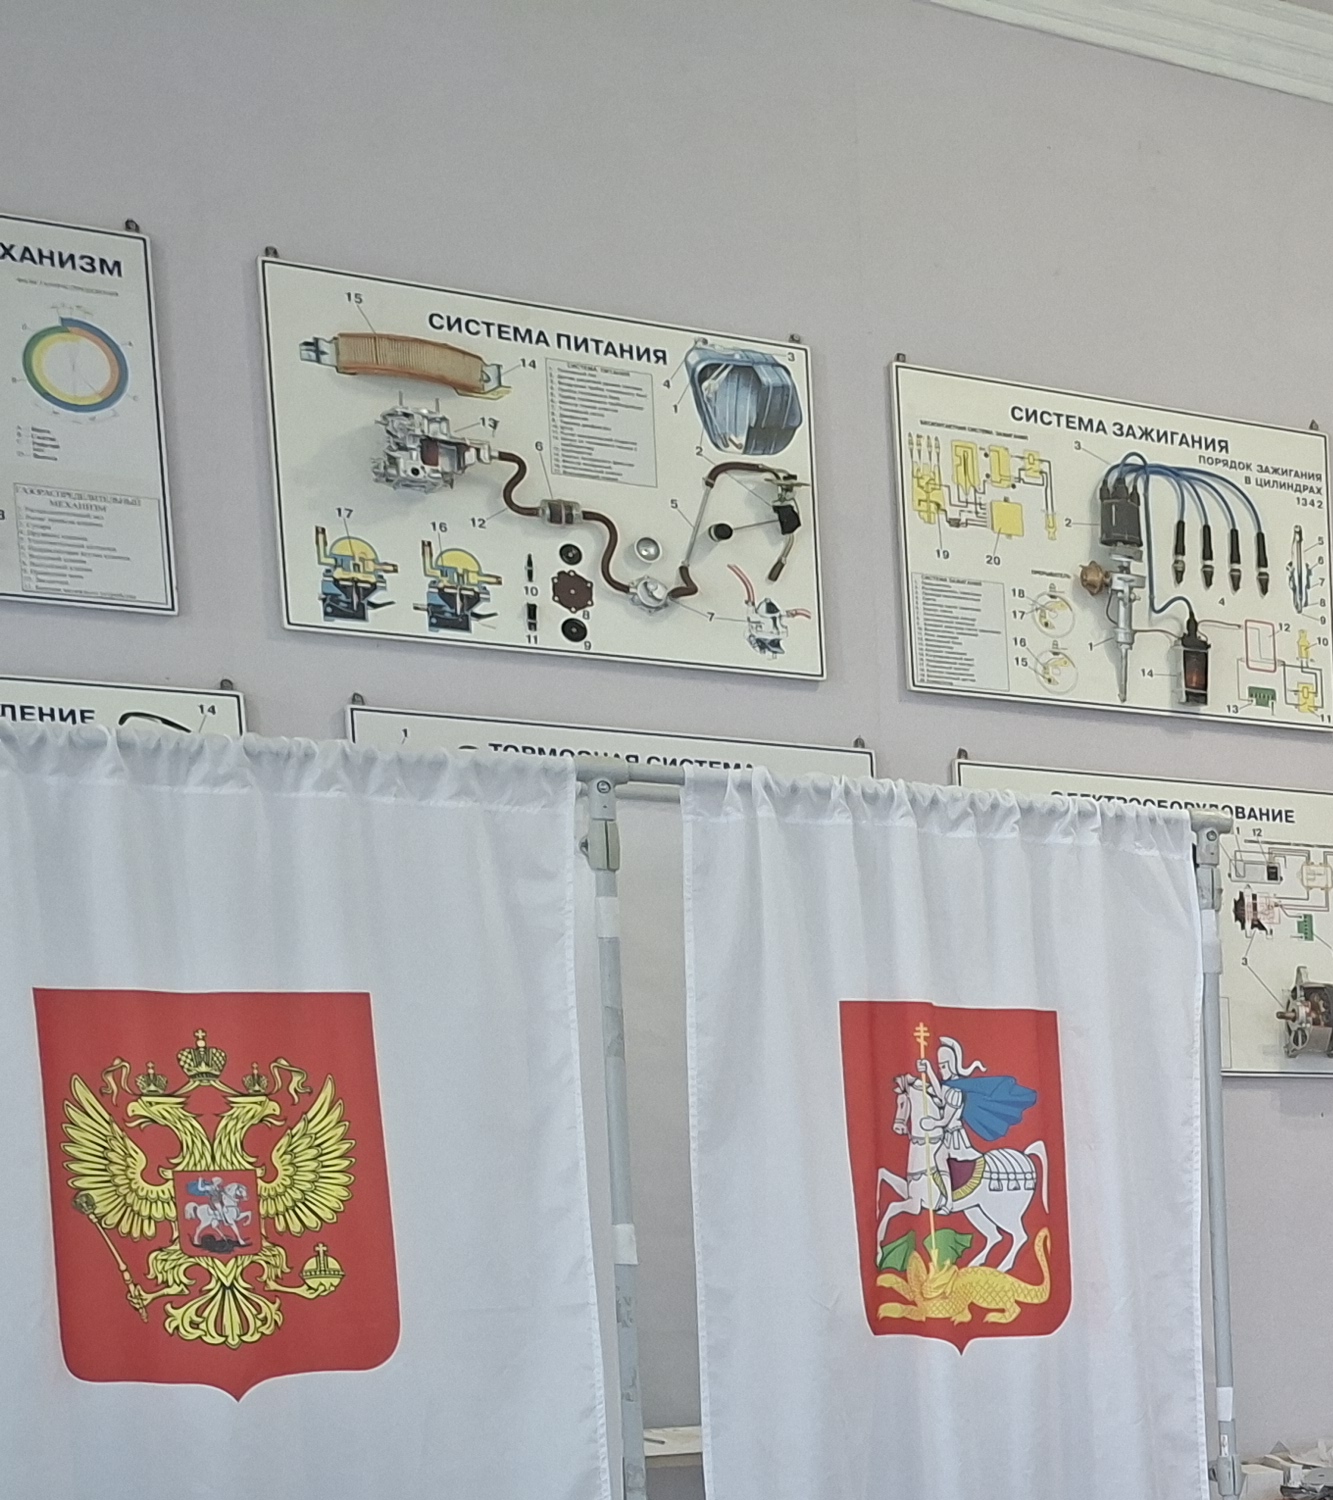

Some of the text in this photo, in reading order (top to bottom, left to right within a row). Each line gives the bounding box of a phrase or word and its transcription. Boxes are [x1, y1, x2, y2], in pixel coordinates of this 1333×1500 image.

[346, 291, 363, 304] 15
[428, 312, 668, 366] СИСТЕМА ПИТАНИЯ
[787, 352, 795, 362] 3
[520, 357, 536, 369] 14
[663, 378, 671, 389] 4
[672, 404, 678, 413] 1
[480, 417, 499, 430] 13
[1010, 405, 1230, 454] СИСТЕМА ЗАЖИГАНИЯ
[535, 441, 543, 451] 6
[695, 445, 703, 456] 2
[1074, 441, 1082, 450] 3
[1198, 455, 1323, 482] ПОРЯДОК ЗАЖИГАНИЯ
[1244, 475, 1323, 496] В ЦИЛИНДРАХ
[670, 499, 678, 509] 5
[335, 507, 353, 519] 17
[430, 520, 448, 533] 16
[470, 517, 487, 529] 12
[1064, 518, 1072, 527] 2
[1317, 536, 1324, 546] 5
[935, 548, 950, 559] 19
[985, 555, 1001, 566] 20
[1317, 556, 1324, 565] 6
[1318, 578, 1325, 587] 7
[523, 585, 538, 597] 10
[1011, 588, 1025, 599] 18
[1218, 597, 1225, 606] 4
[1319, 598, 1326, 607] 8
[582, 609, 590, 620] 8
[706, 611, 715, 622] 7
[1012, 610, 1026, 620] 17
[1319, 616, 1326, 625] 9
[1278, 622, 1291, 632] 12
[525, 634, 538, 645] 11
[1012, 637, 1027, 647] 16
[1316, 636, 1329, 646] 10
[583, 640, 591, 651] 9
[1088, 642, 1094, 651] 1
[1014, 656, 1028, 667] 15
[1141, 668, 1153, 678] 14
[198, 703, 216, 716] 14
[1226, 704, 1239, 714] 13
[1319, 713, 1332, 724] 11
[1252, 827, 1263, 837] 12
[1241, 957, 1248, 966] 3
